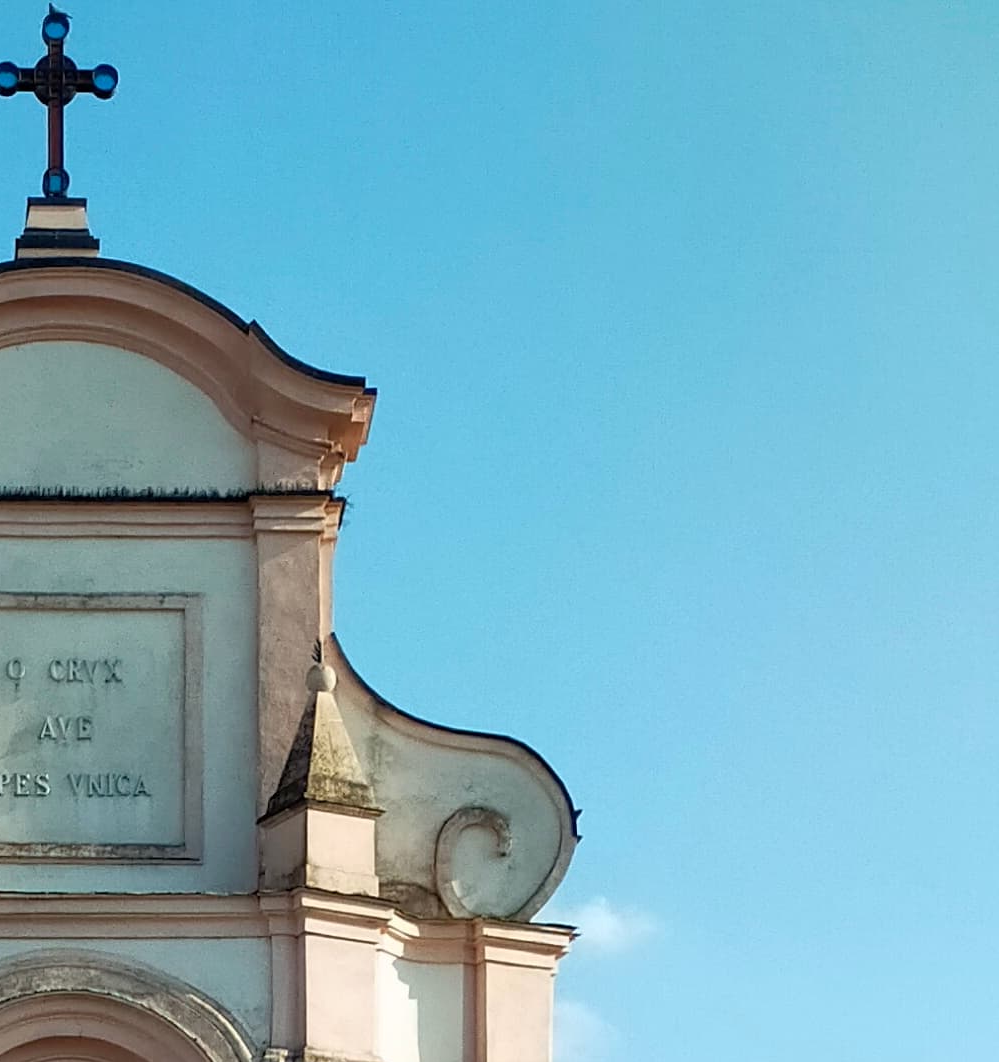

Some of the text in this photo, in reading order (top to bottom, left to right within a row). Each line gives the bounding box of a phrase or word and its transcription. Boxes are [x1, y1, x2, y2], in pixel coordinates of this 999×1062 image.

[47, 657, 123, 684] CRVX
[37, 715, 93, 741] AVE
[66, 772, 152, 798] VNICA
